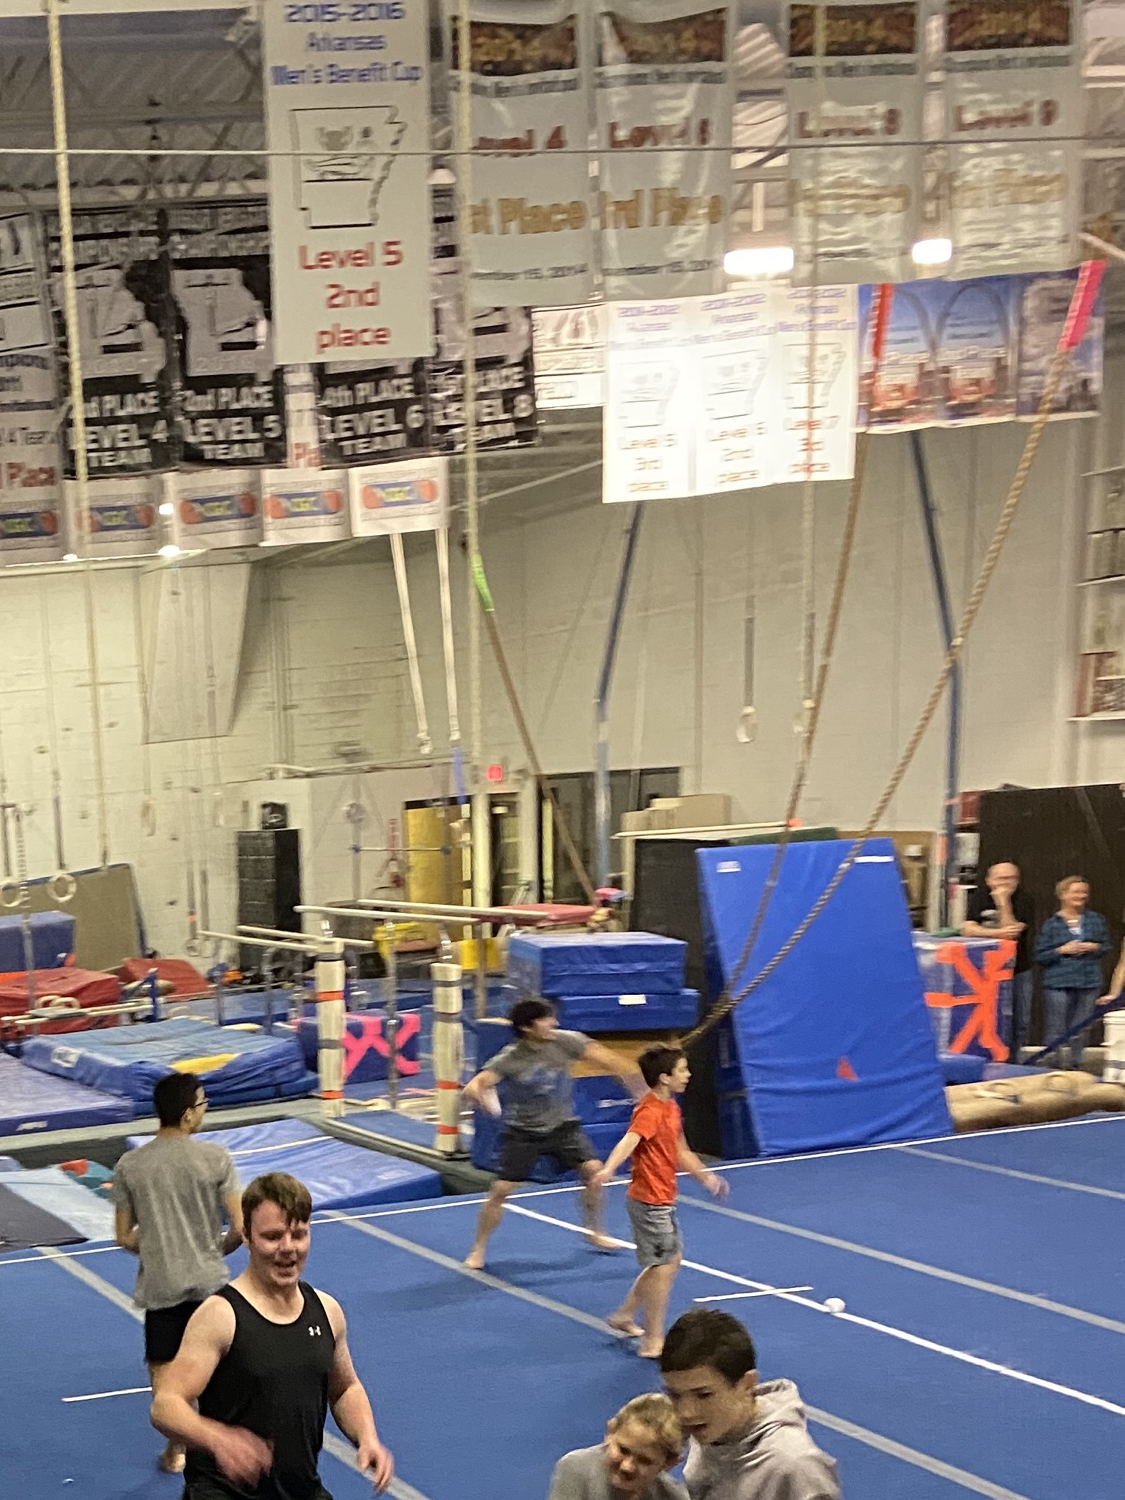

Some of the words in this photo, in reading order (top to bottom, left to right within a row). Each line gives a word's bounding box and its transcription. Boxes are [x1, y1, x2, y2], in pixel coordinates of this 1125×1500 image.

[284, 2, 407, 23] 2015-2016
[298, 242, 375, 270] Level
[380, 240, 403, 266] 5
[324, 281, 380, 309] 2nd
[316, 323, 391, 354] place
[262, 414, 283, 439] 5
[405, 403, 425, 430] 6
